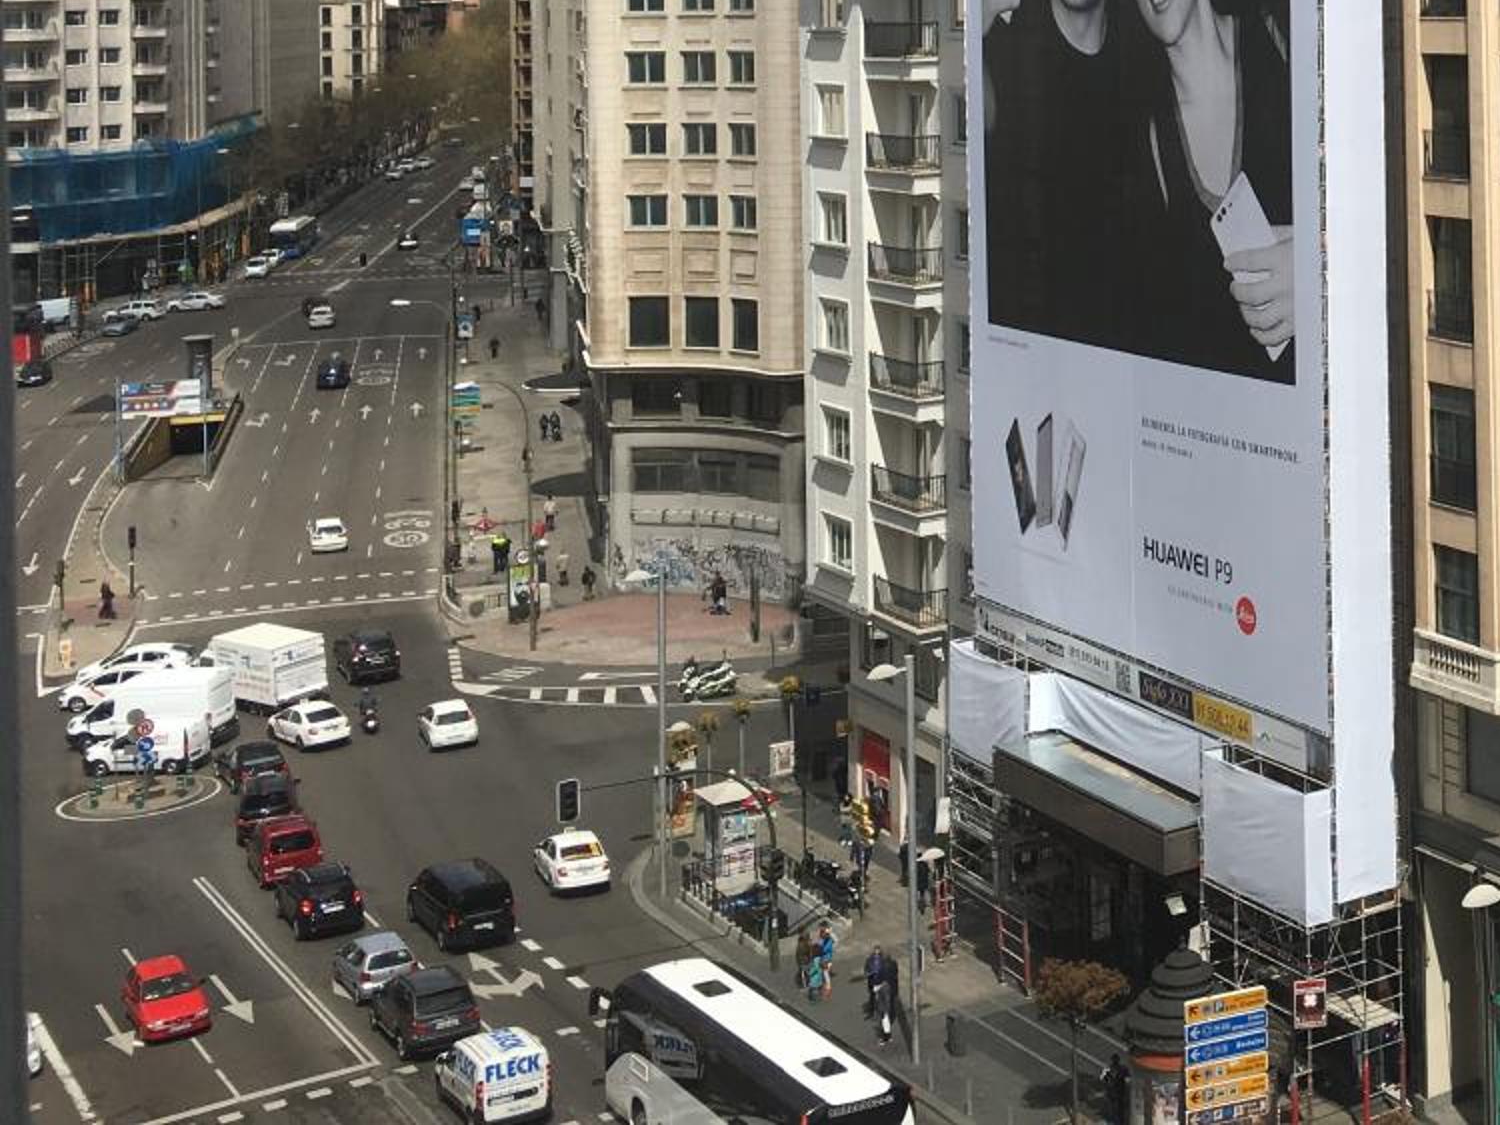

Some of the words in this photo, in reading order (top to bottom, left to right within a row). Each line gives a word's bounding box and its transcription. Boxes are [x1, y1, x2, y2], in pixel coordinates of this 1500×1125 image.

[1177, 426, 1187, 438] LA
[1143, 535, 1209, 578] HUAWEI
[1215, 557, 1233, 585] P9
